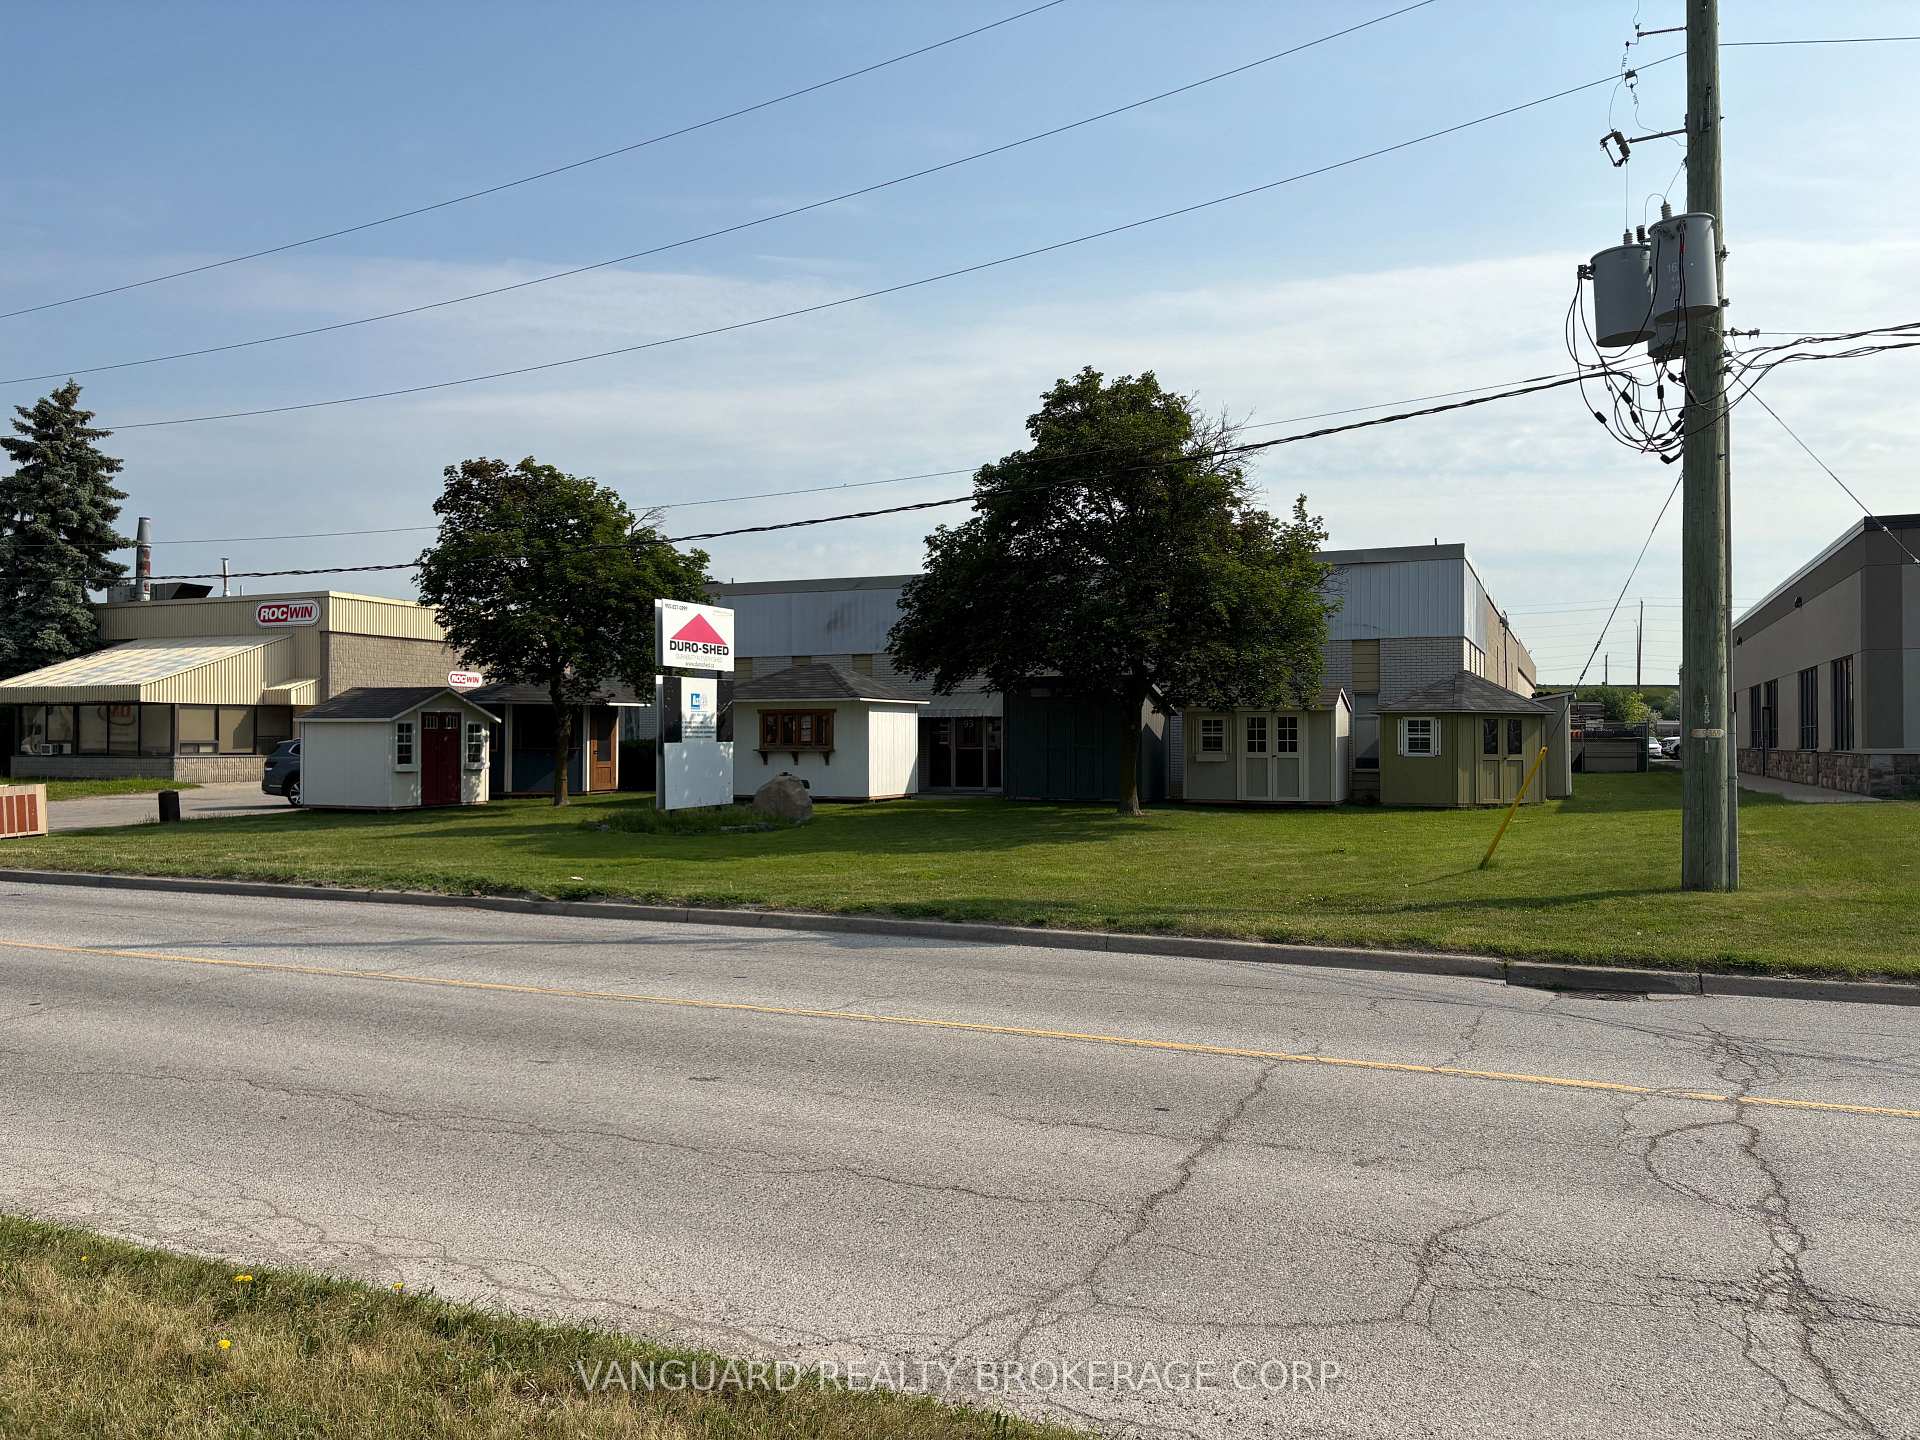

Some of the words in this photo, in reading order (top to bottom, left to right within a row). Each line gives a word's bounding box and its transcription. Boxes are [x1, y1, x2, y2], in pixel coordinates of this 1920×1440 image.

[260, 605, 313, 621] ROCWIN
[669, 640, 729, 656] DURO-SHED
[451, 673, 480, 684] ROCWIN
